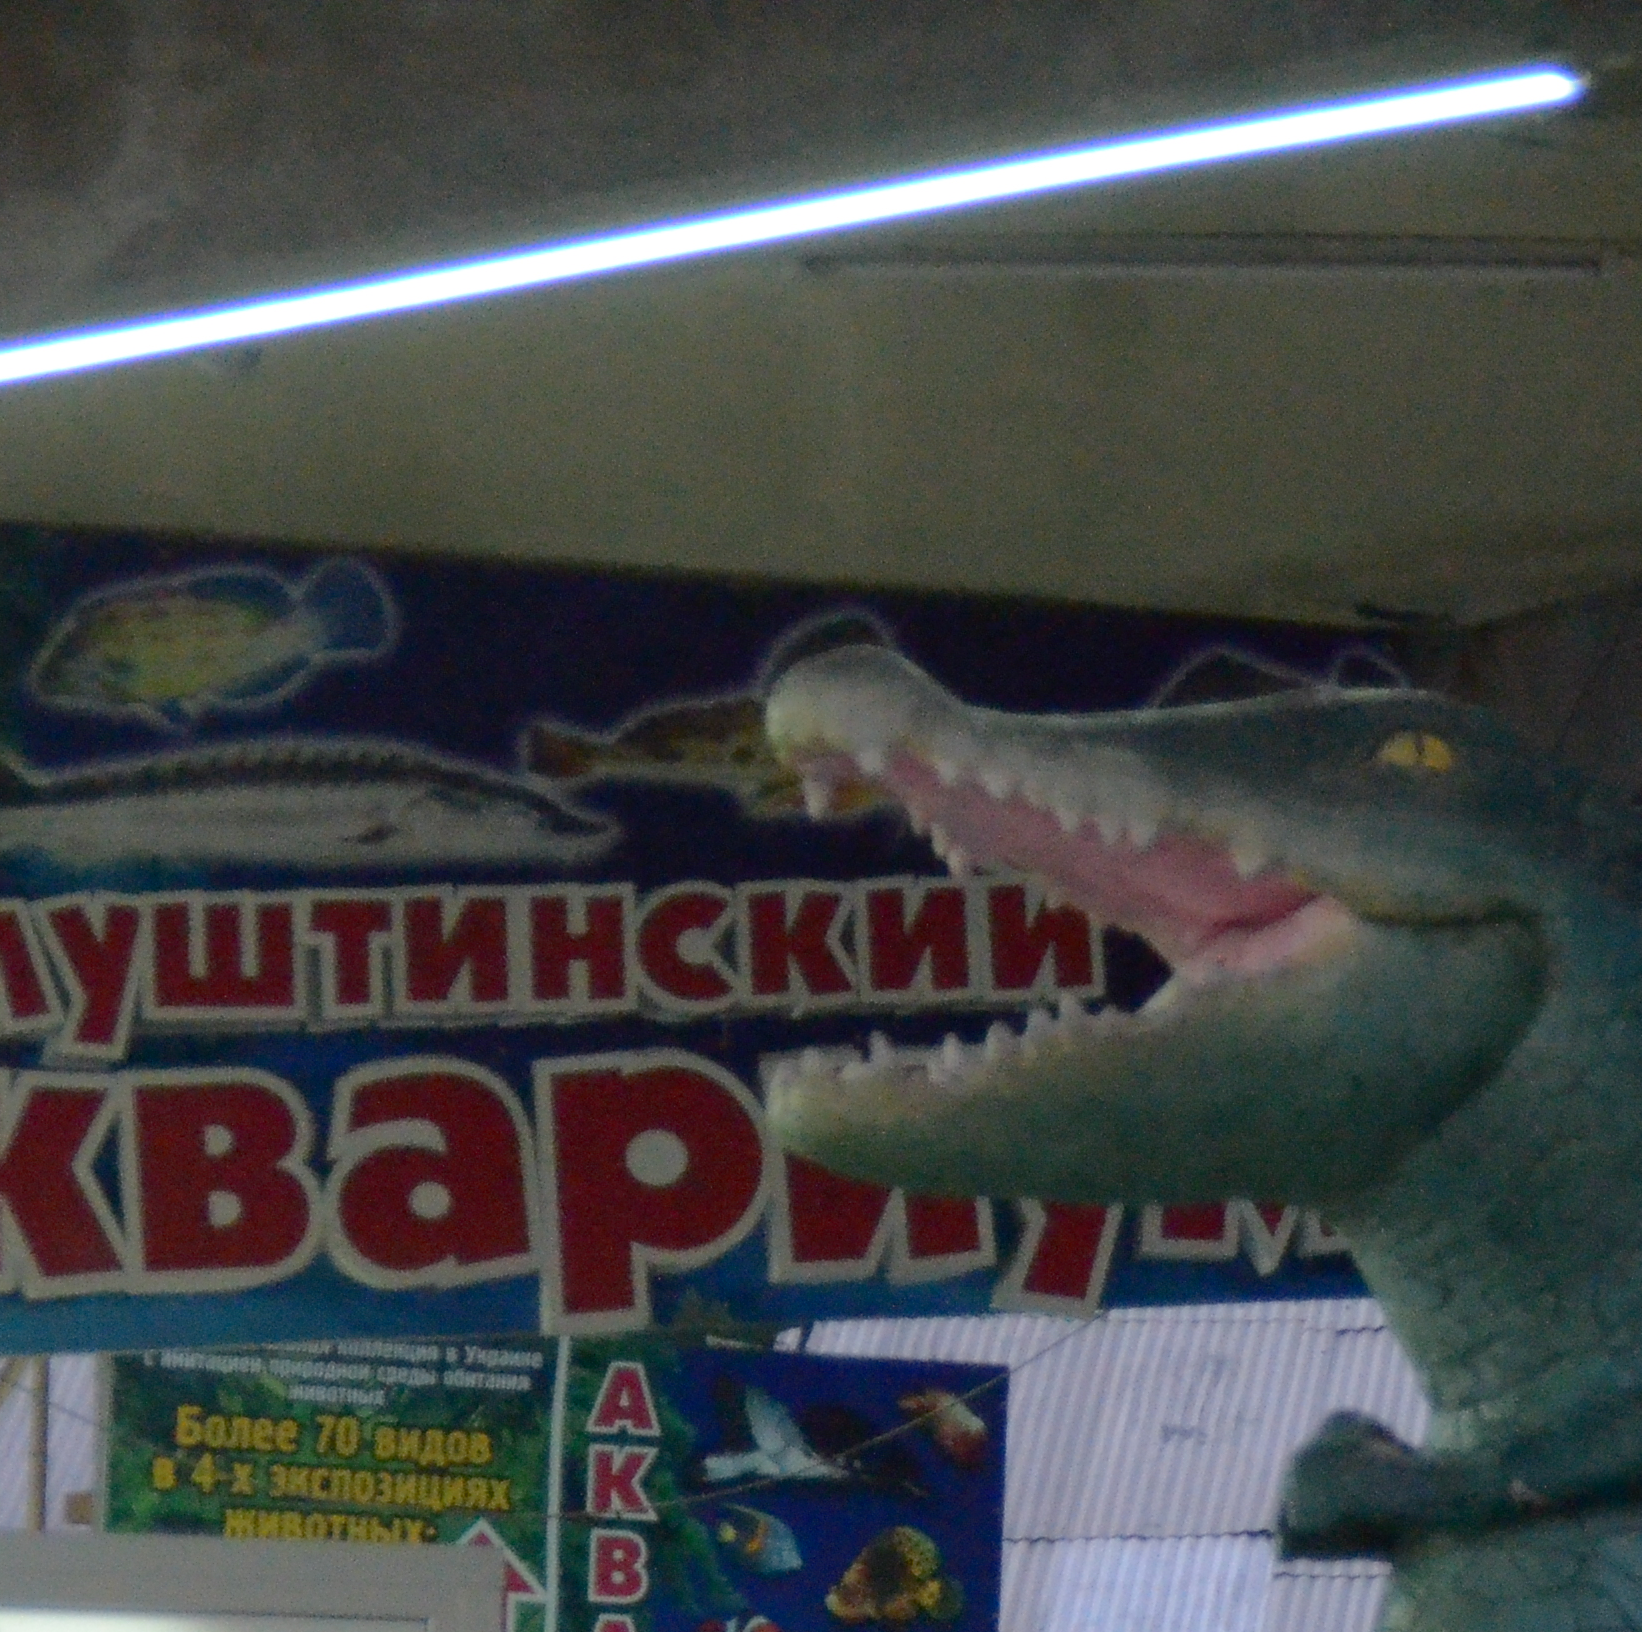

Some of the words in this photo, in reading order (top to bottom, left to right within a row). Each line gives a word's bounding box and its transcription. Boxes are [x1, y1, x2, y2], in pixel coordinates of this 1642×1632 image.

[175, 1403, 300, 1454] Более
[315, 1415, 361, 1458] 70
[373, 1427, 494, 1466] видов
[152, 1456, 176, 1492] в
[268, 1463, 512, 1511] экспозициях
